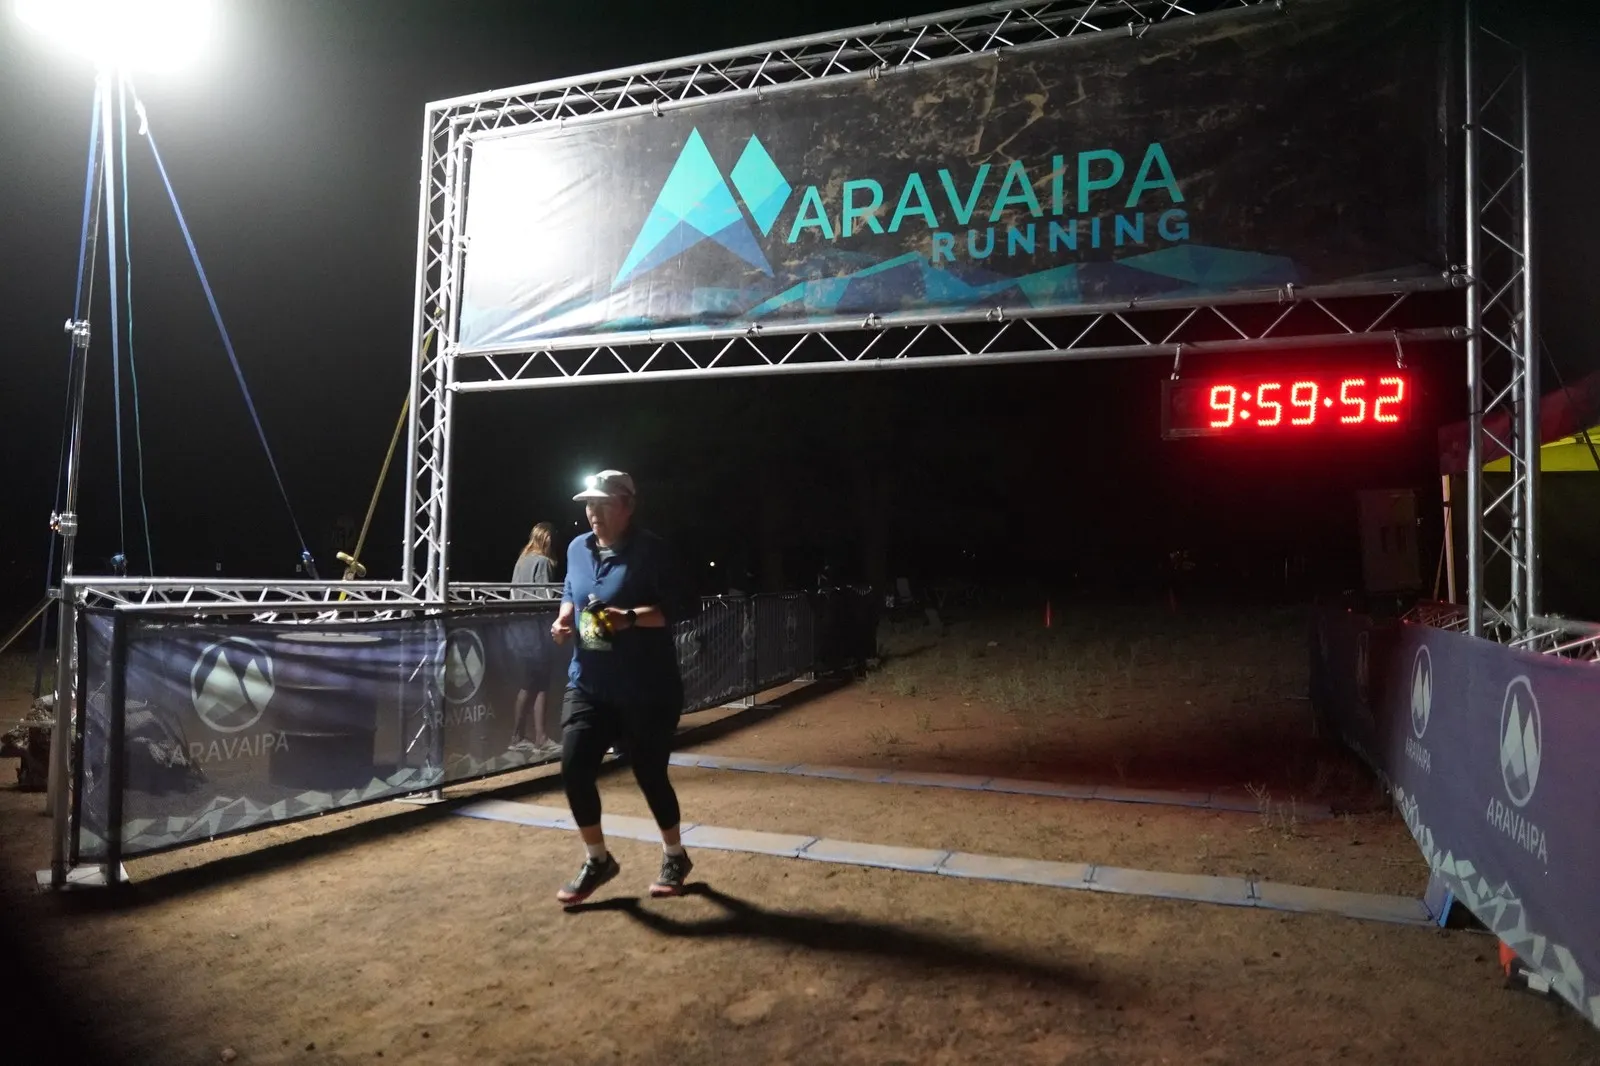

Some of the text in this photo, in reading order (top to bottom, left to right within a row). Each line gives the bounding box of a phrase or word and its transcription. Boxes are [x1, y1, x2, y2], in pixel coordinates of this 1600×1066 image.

[787, 142, 1186, 244] ARAVAIPA
[931, 208, 1190, 264] RUNNING
[170, 730, 290, 768] ARAVAIPA
[1486, 797, 1549, 865] ARAVAIPA
